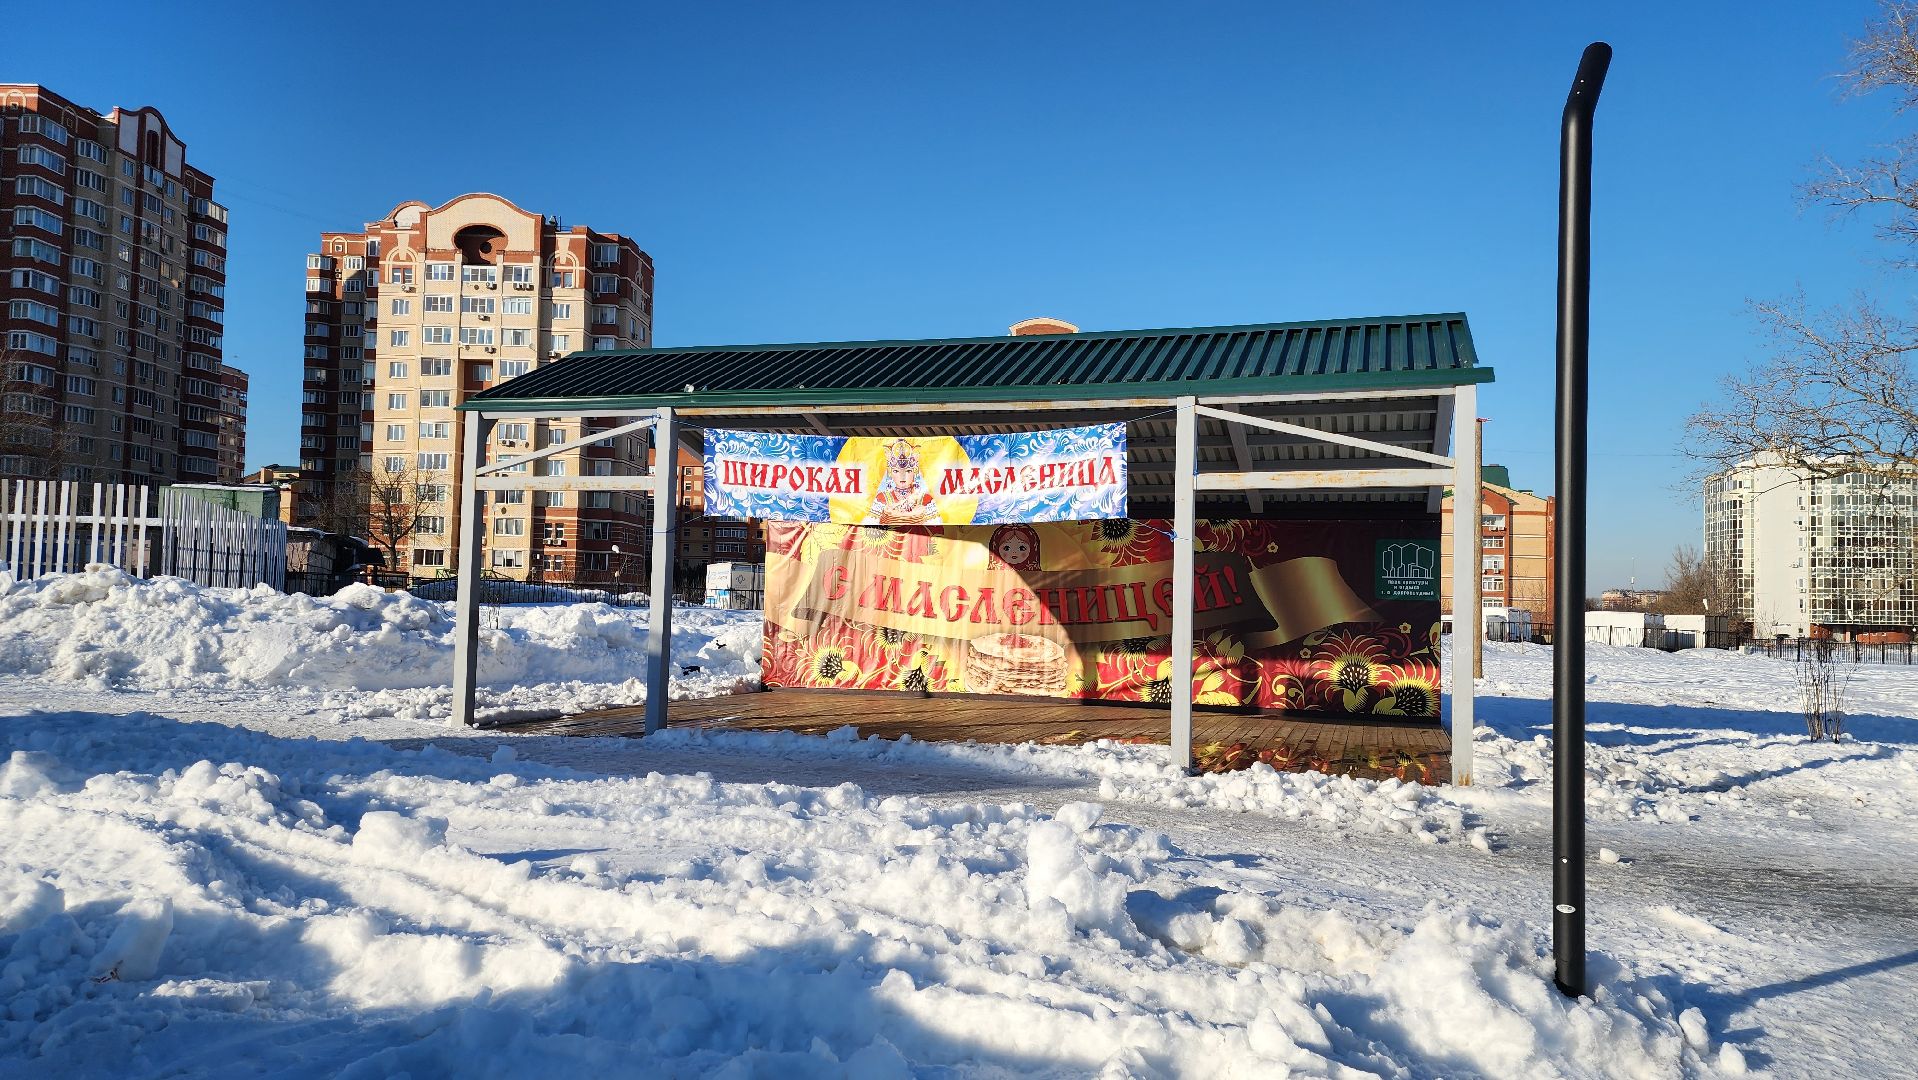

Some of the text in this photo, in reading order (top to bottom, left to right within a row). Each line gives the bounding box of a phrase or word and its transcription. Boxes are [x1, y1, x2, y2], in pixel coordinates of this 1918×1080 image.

[722, 456, 1118, 496] ШИРОКАЯ МАСЛЕНИЦА
[822, 564, 850, 600] С
